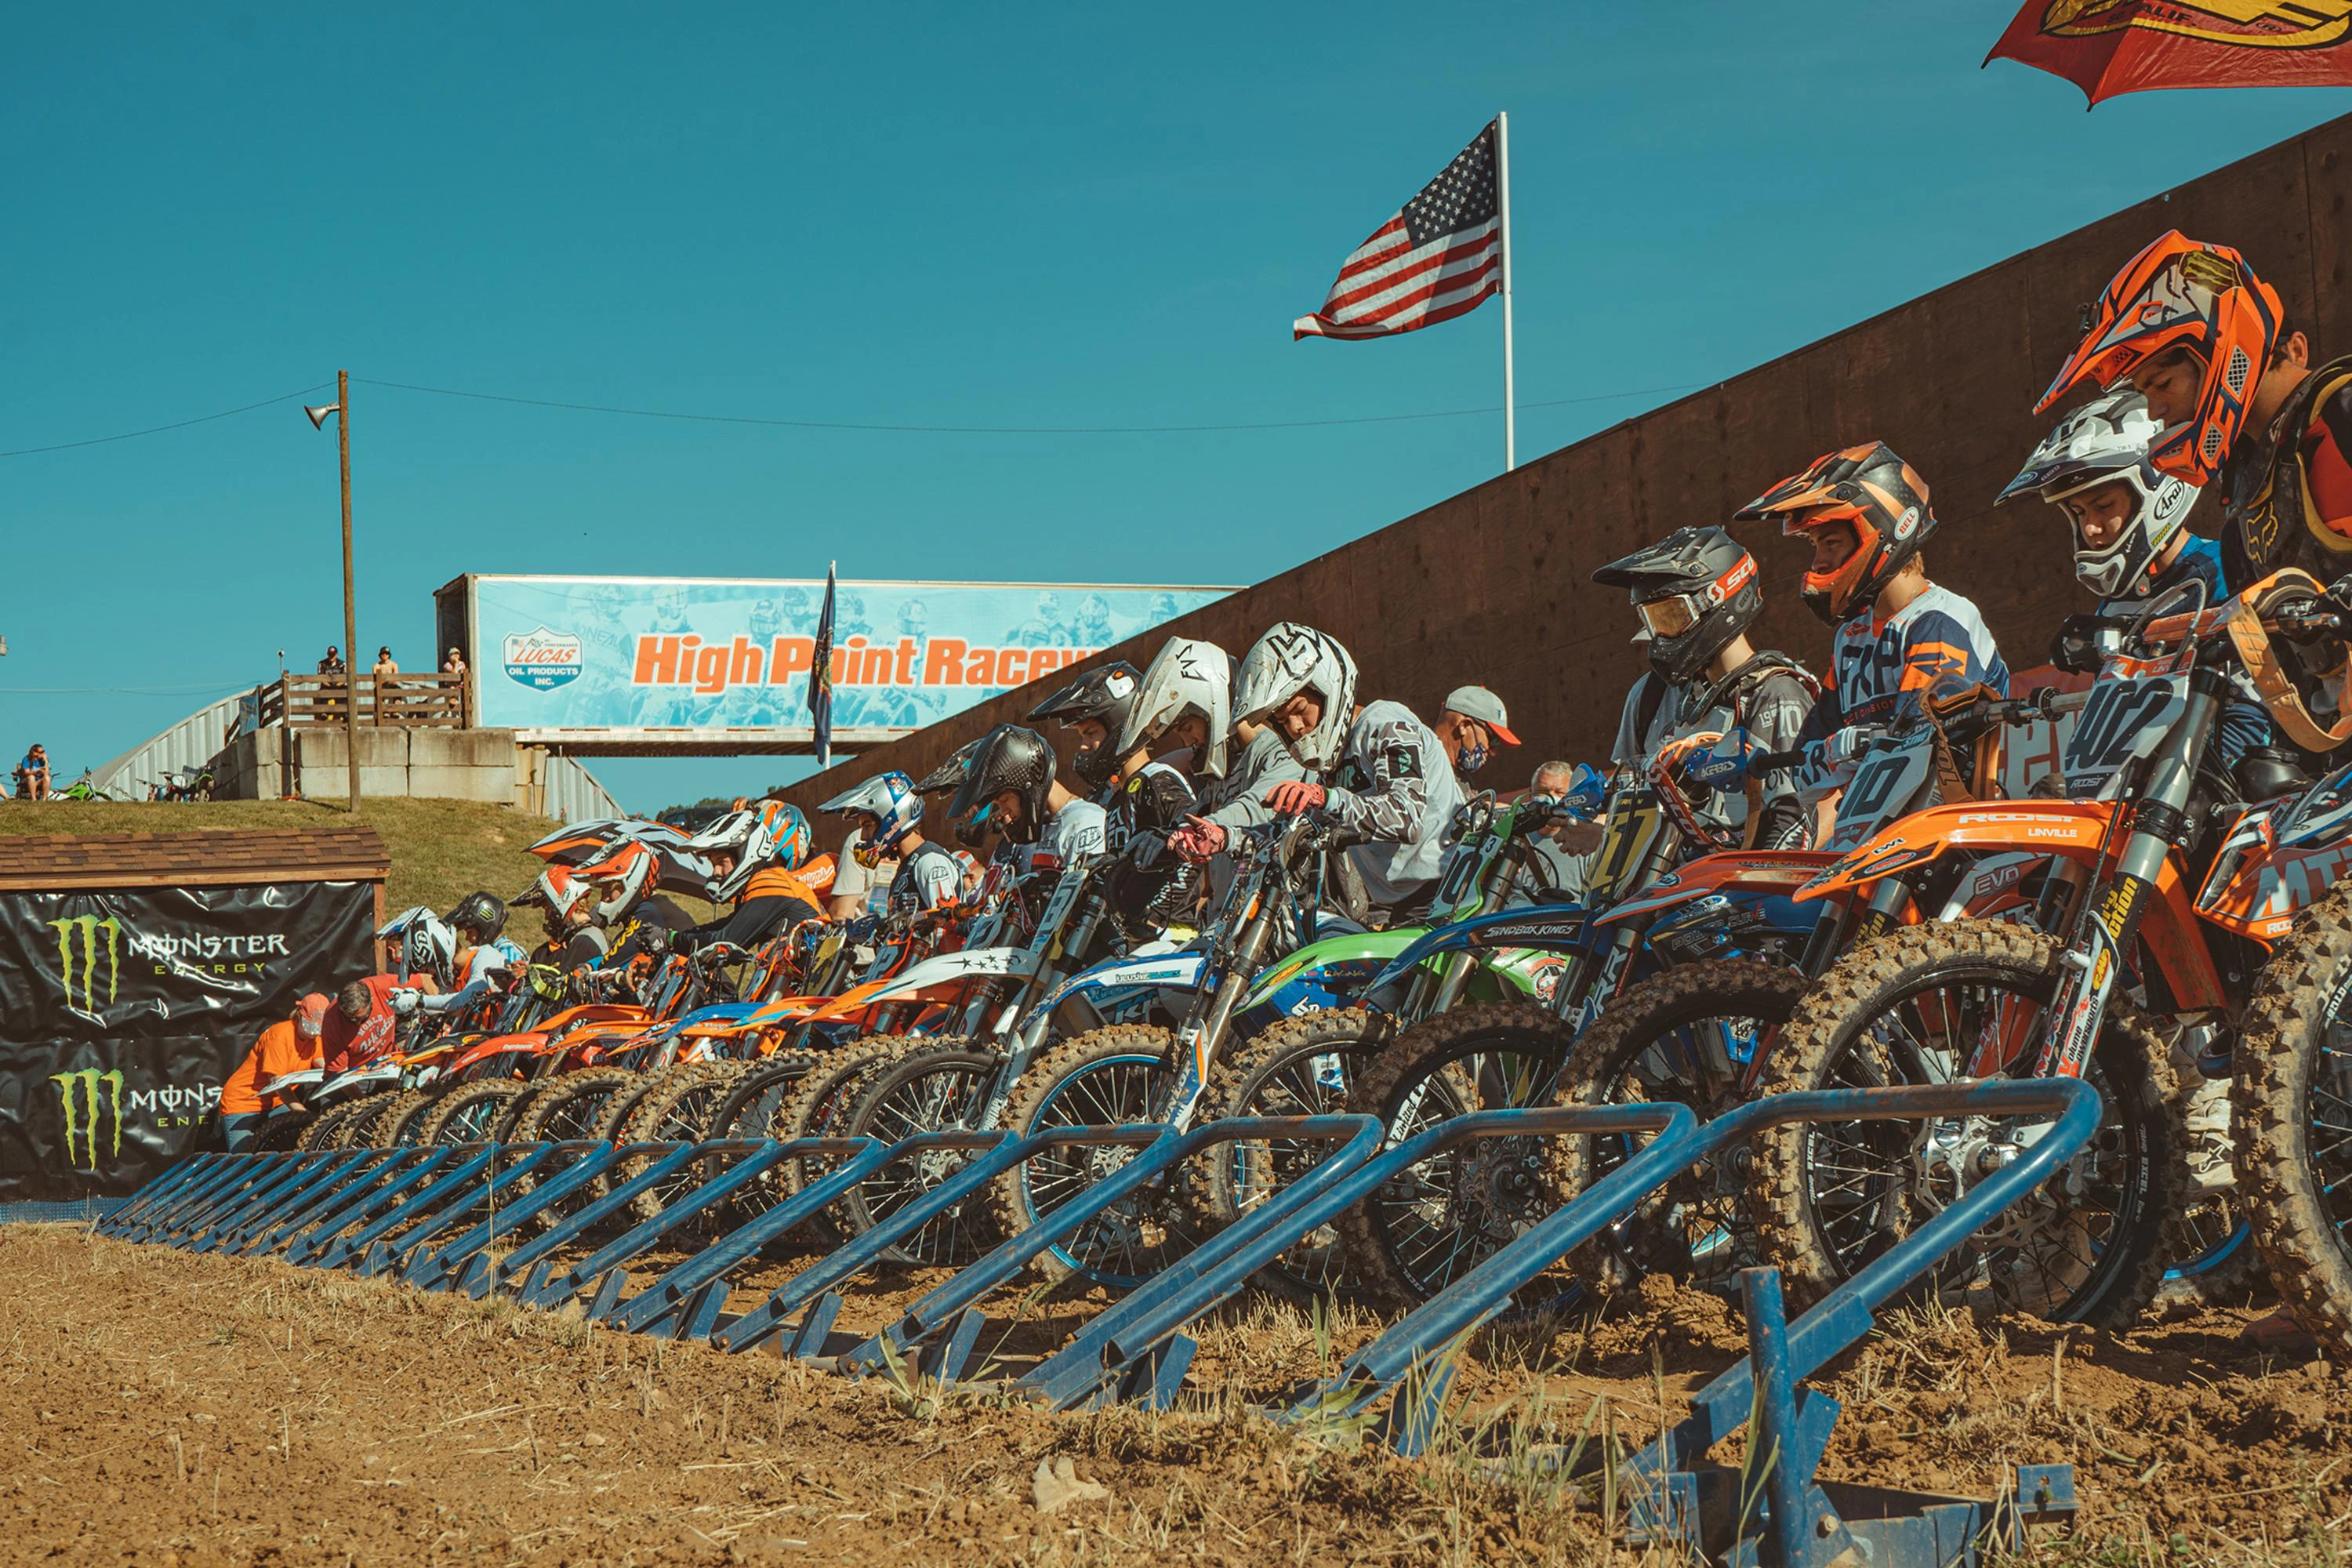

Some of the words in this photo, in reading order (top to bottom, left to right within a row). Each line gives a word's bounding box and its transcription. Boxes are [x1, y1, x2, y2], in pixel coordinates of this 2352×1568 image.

[2158, 483, 2183, 516] Arai
[1898, 513, 1916, 535] BELL
[508, 666, 525, 676] OIL
[527, 666, 579, 676] PRODUCTS
[513, 648, 577, 664] LUCAS
[633, 636, 763, 693] High
[534, 677, 555, 686] INC.
[1836, 755, 1911, 822] 10
[1485, 837, 1497, 853] 3
[2027, 827, 2078, 838] LINVILLE
[1973, 866, 2020, 897] EVO
[2104, 876, 2140, 944] ction
[127, 932, 290, 961] MONSTER
[1483, 926, 1538, 938] SANDBOX
[1537, 925, 1577, 936] KINGS
[129, 1082, 223, 1113] MONS
[1806, 1131, 1815, 1171] EXCEL
[2139, 1156, 2149, 1195] EXCEL
